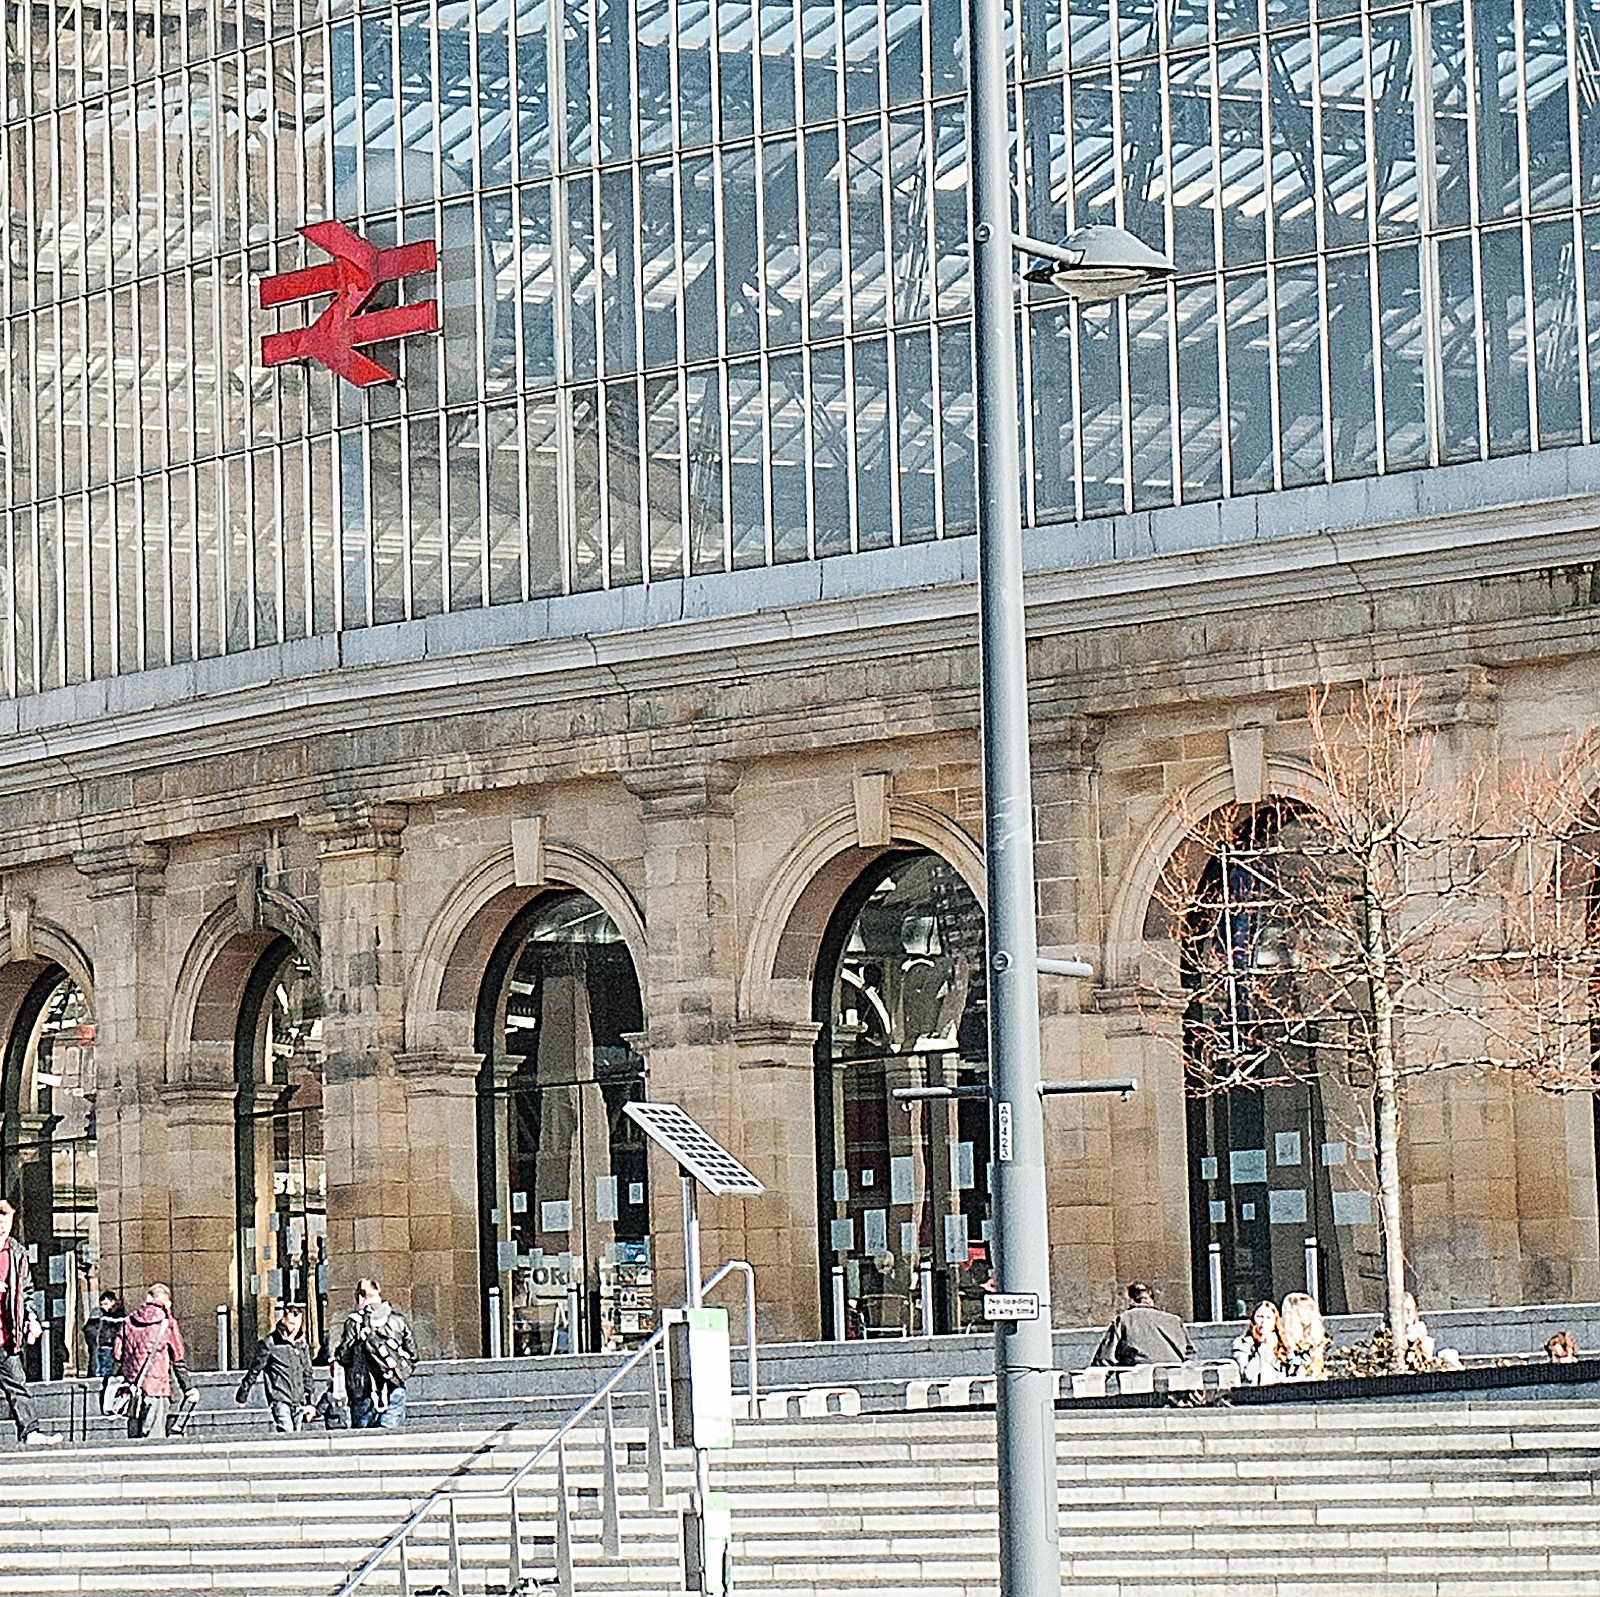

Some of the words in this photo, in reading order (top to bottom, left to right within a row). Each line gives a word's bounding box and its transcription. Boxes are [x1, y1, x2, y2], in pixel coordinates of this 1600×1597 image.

[1000, 1105, 1009, 1159] A9423
[988, 1297, 1001, 1305] No
[1003, 1297, 1034, 1306] loading
[988, 1307, 997, 1315] at
[999, 1307, 1014, 1316] any
[1016, 1307, 1034, 1315] time
